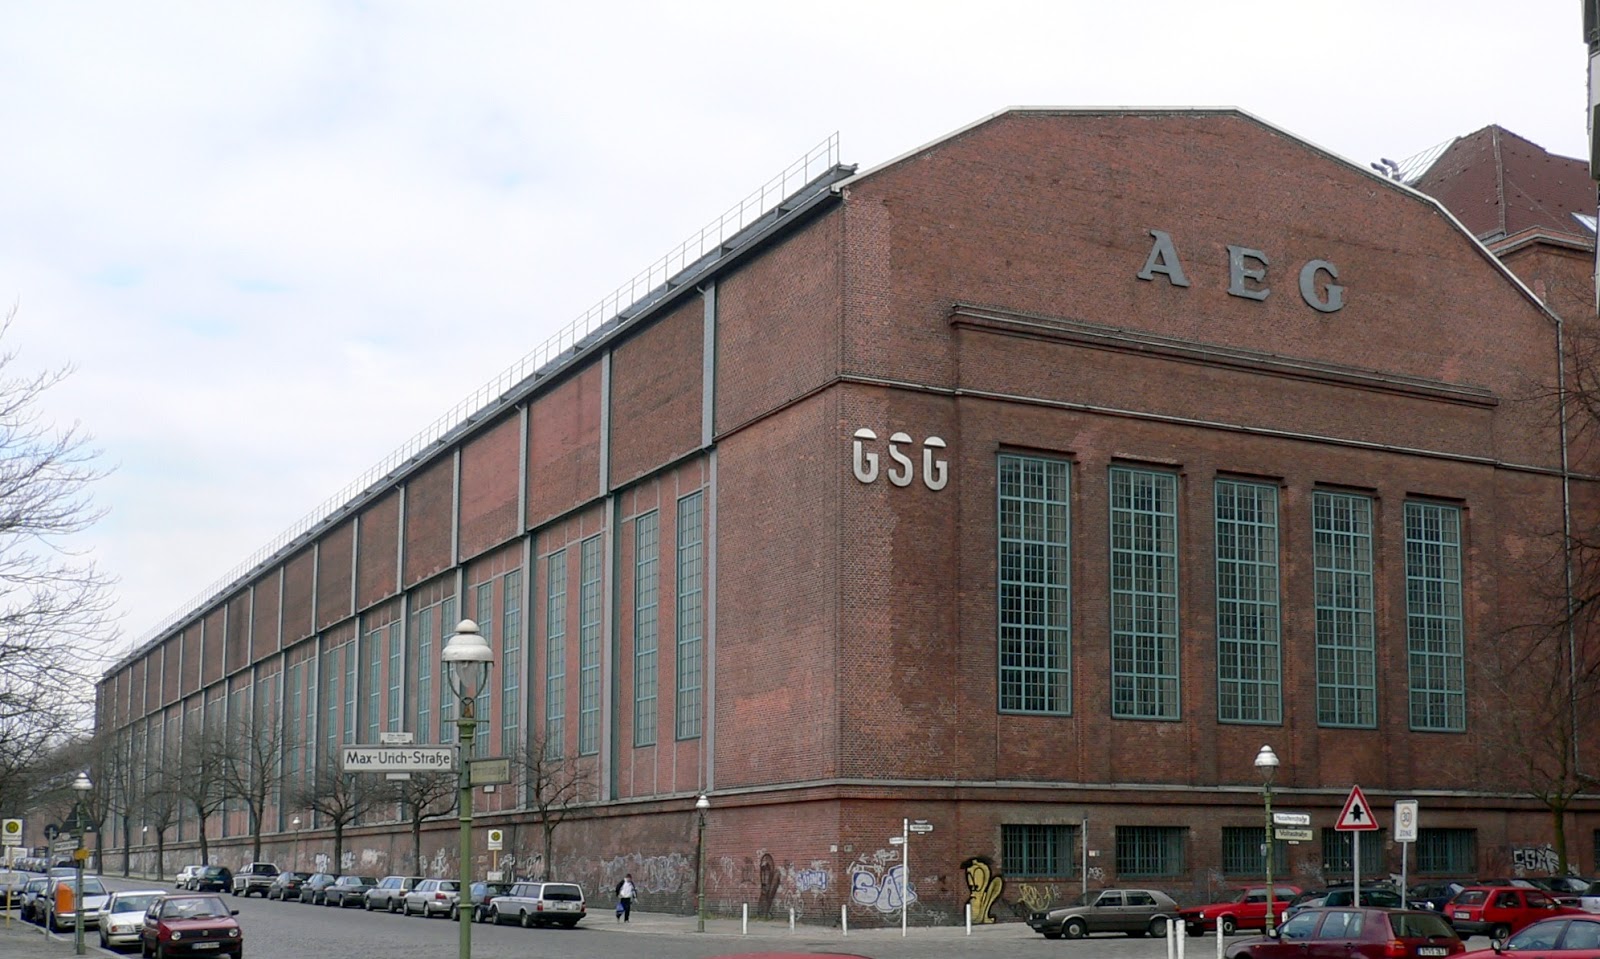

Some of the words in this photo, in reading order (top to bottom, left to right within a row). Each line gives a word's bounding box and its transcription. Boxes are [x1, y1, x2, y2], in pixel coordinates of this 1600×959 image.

[1136, 229, 1344, 313] AEG
[852, 427, 948, 491] GSG
[346, 751, 450, 767] Max-Urich-Straße
[1401, 811, 1411, 822] 30
